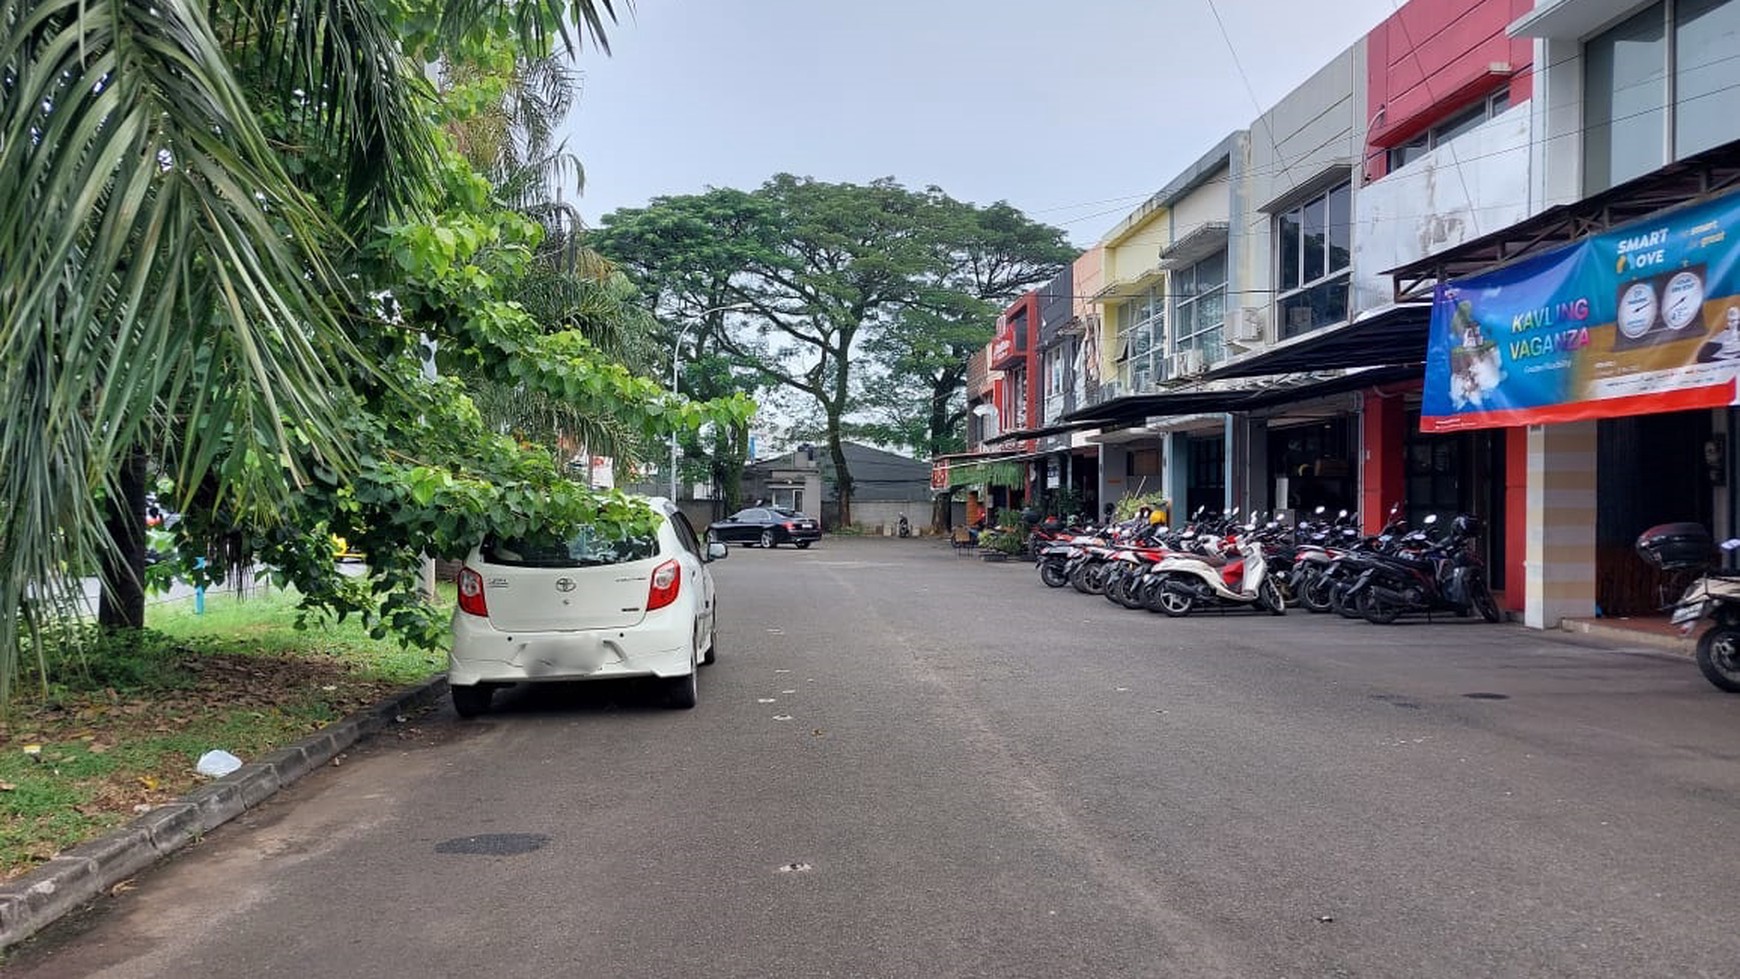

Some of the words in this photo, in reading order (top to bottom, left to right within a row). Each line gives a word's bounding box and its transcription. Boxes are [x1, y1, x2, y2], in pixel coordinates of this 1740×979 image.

[1617, 228, 1669, 255] SMART
[1511, 298, 1589, 334] KAVLING
[1509, 327, 1590, 360] VAGANZA
